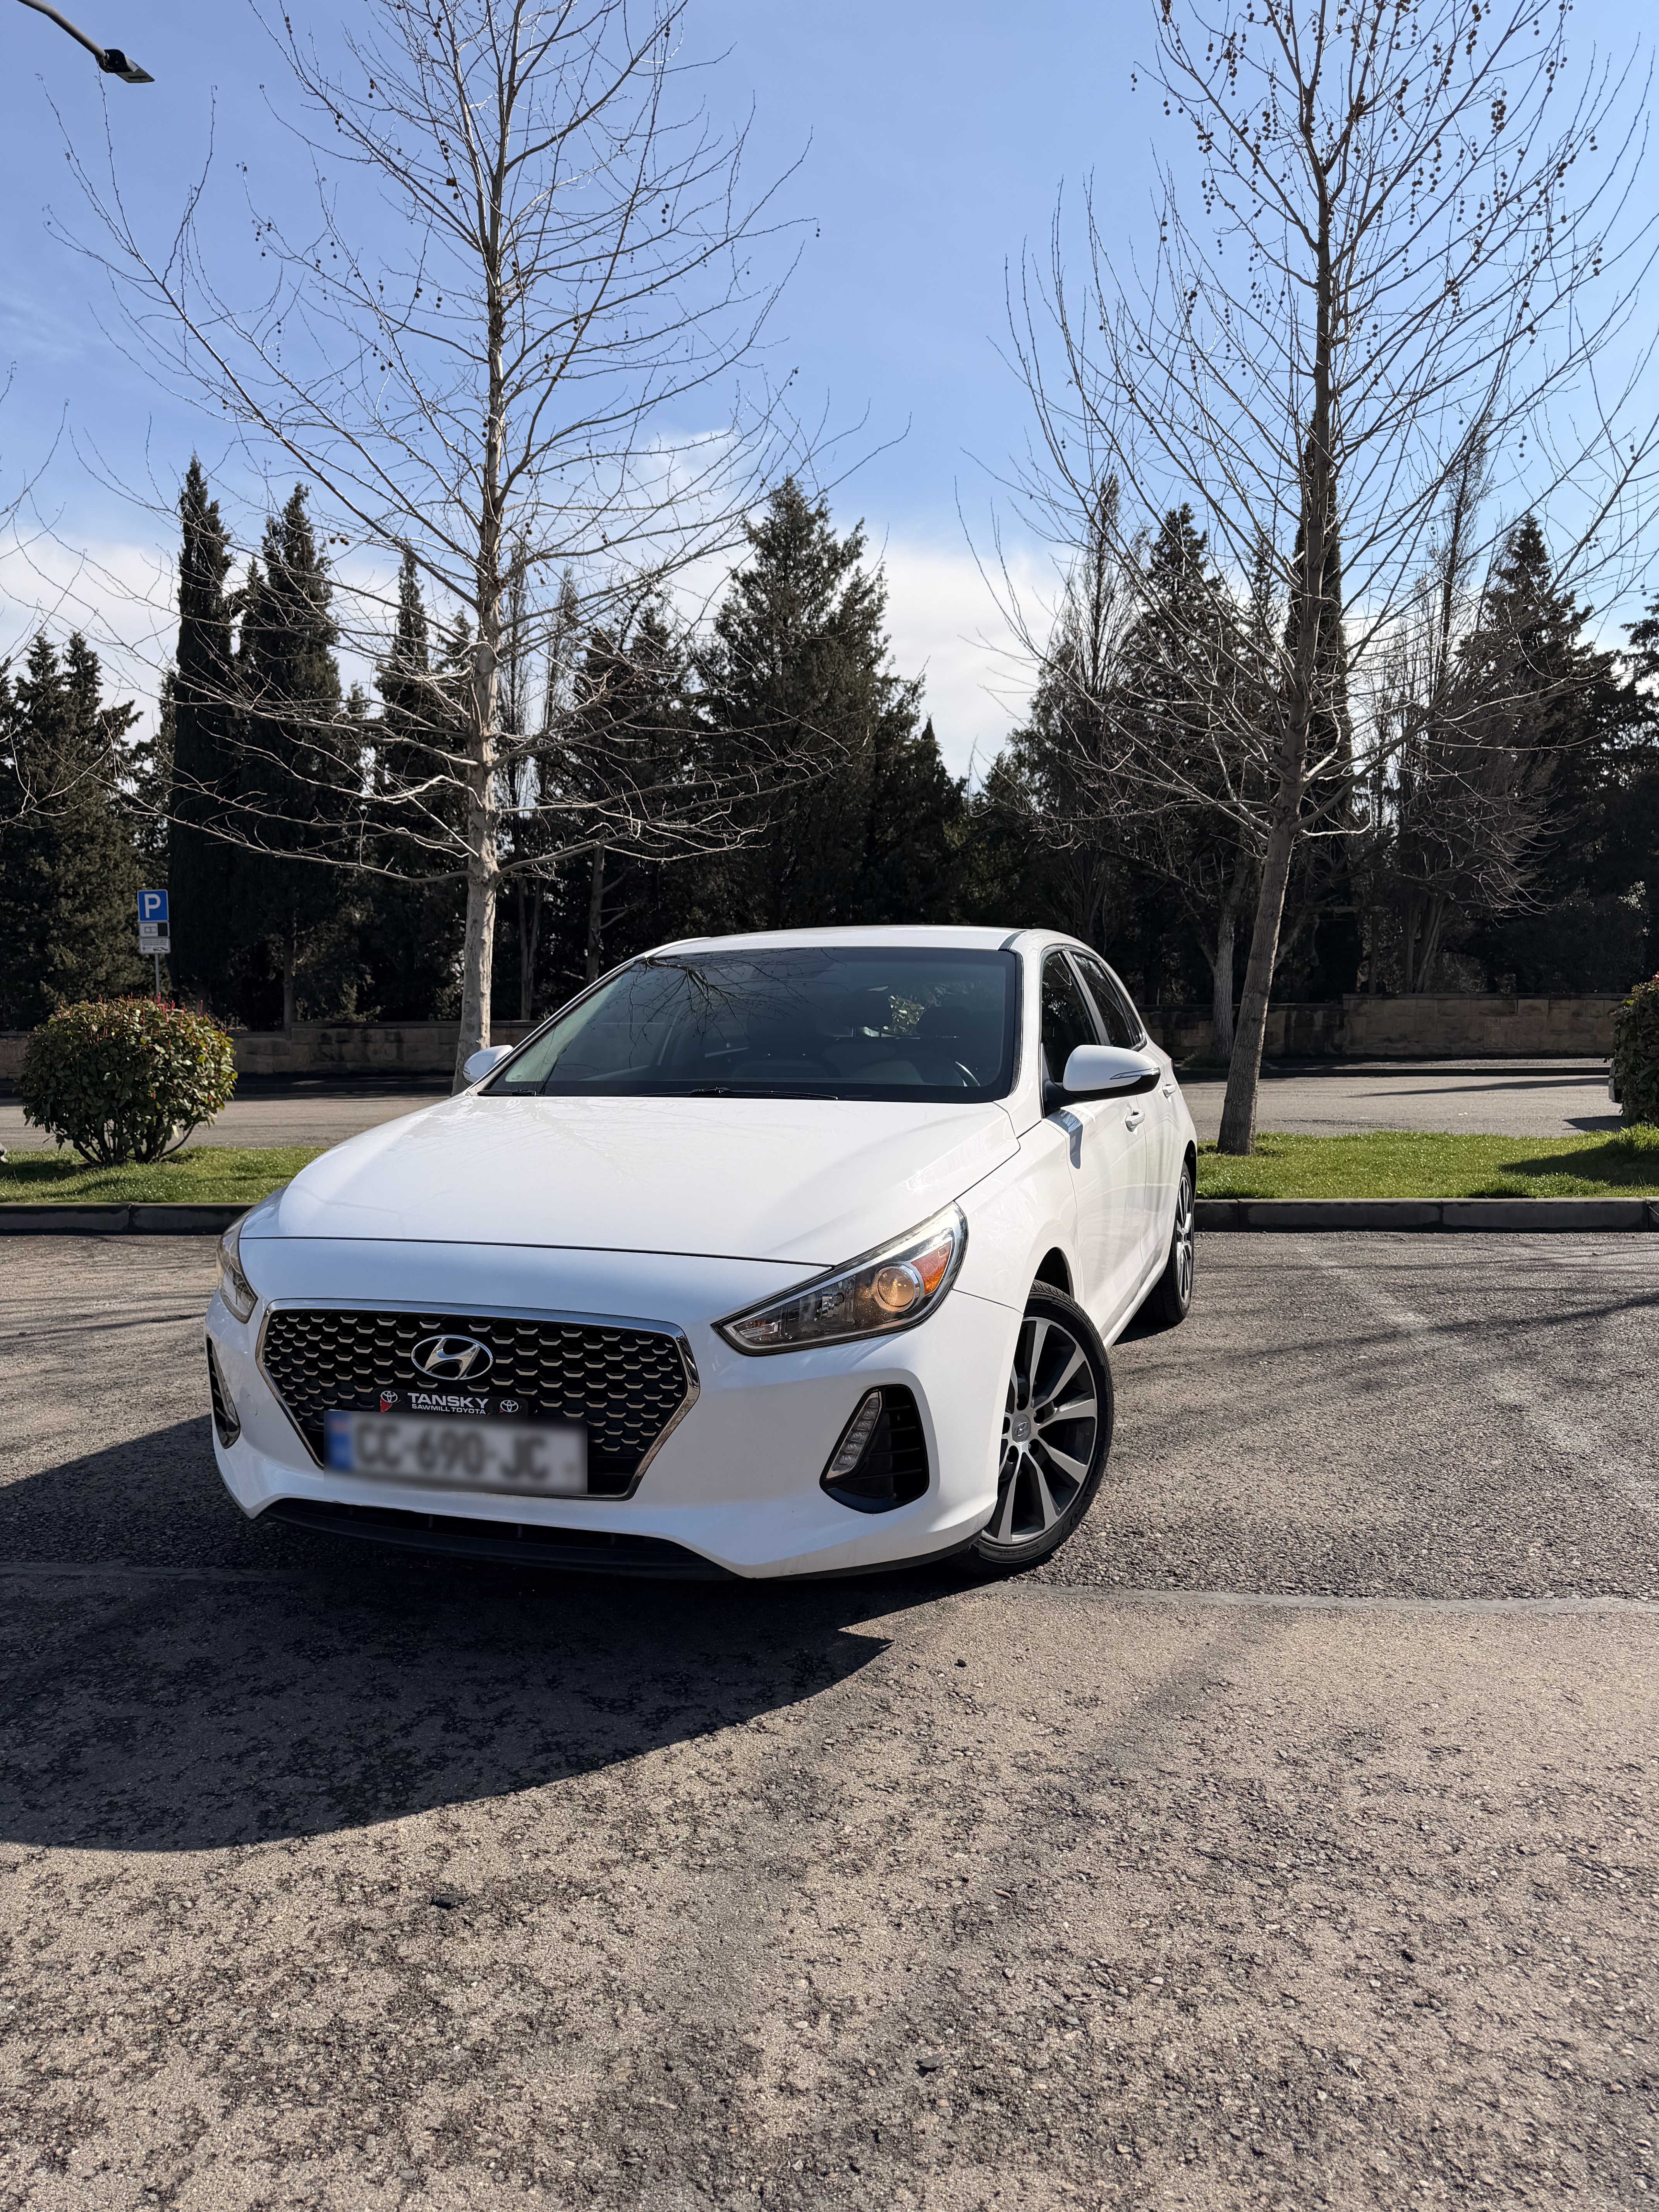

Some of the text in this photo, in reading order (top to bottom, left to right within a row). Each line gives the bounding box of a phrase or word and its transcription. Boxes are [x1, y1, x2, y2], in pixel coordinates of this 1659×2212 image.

[144, 893, 161, 918] P
[407, 1393, 489, 1408] TANSKY
[412, 1404, 450, 1412] SAWMILL
